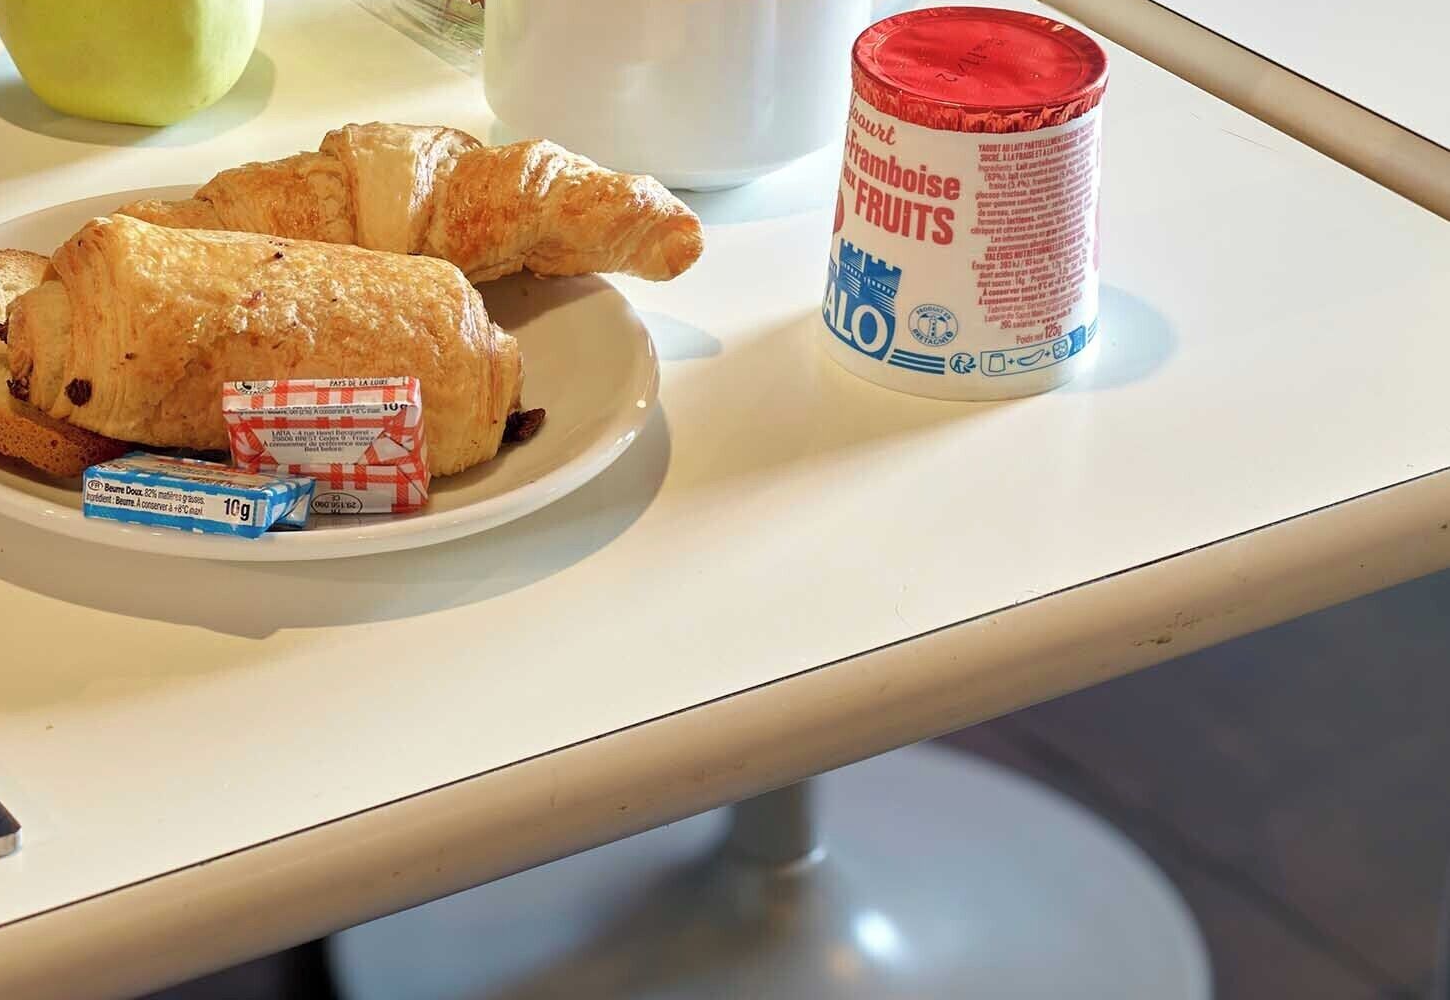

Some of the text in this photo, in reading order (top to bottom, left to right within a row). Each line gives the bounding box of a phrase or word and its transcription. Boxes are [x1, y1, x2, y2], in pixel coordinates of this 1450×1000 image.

[854, 177, 955, 246] FRUITS
[824, 281, 888, 353] ALO
[1017, 335, 1033, 344] Poids
[1045, 322, 1062, 339] 125g
[104, 483, 125, 494] Beurre
[144, 488, 158, 497] 82%
[141, 500, 168, 511] conserver
[224, 498, 250, 521] 10g
